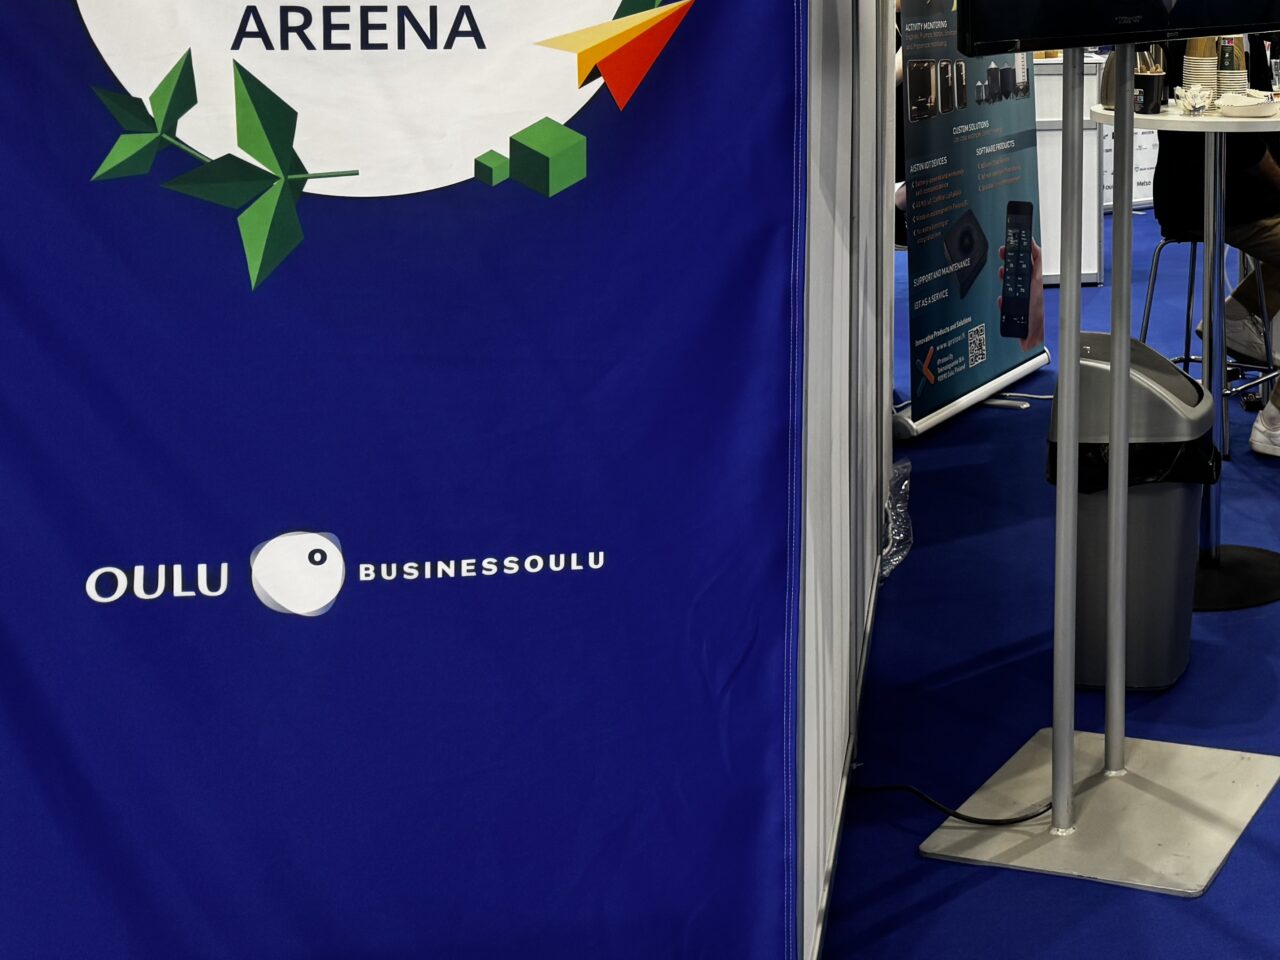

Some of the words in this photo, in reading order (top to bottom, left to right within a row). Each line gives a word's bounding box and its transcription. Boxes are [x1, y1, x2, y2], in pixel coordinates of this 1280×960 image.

[230, 4, 487, 51] AREENA
[905, 22, 923, 32] ACTIVITY
[953, 124, 969, 135] CUSTOM
[968, 120, 989, 132] SOLUTIONS
[976, 144, 995, 156] SOFTWARE
[995, 140, 1015, 151] PRODUCTS
[913, 273, 933, 287] SUPPORT
[85, 562, 229, 603] OULU
[359, 551, 605, 582] BUSINESSOULU
